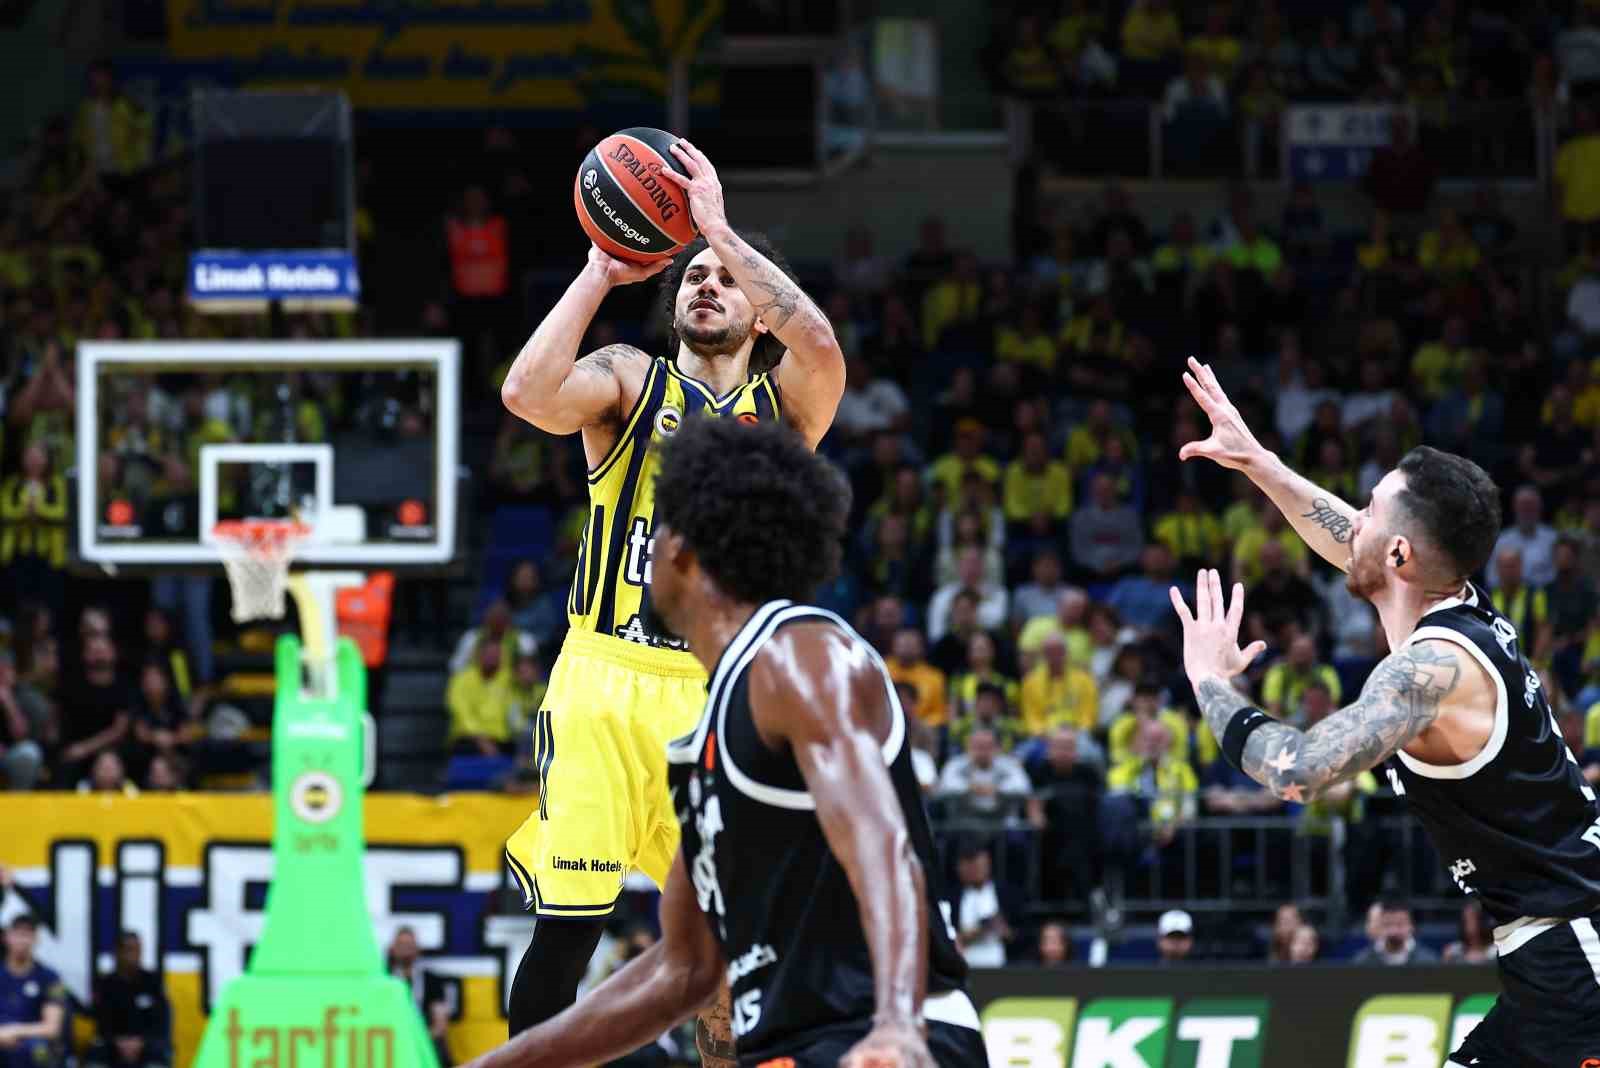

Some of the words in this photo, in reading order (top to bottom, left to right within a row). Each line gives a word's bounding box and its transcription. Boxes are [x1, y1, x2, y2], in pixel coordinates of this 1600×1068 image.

[610, 143, 681, 222] SPALDING
[591, 186, 651, 245] EuroLeague
[552, 855, 587, 871] Limak
[591, 859, 622, 872] Hotels
[224, 1005, 396, 1068] tarfin
[980, 1015, 1261, 1068] BKT
